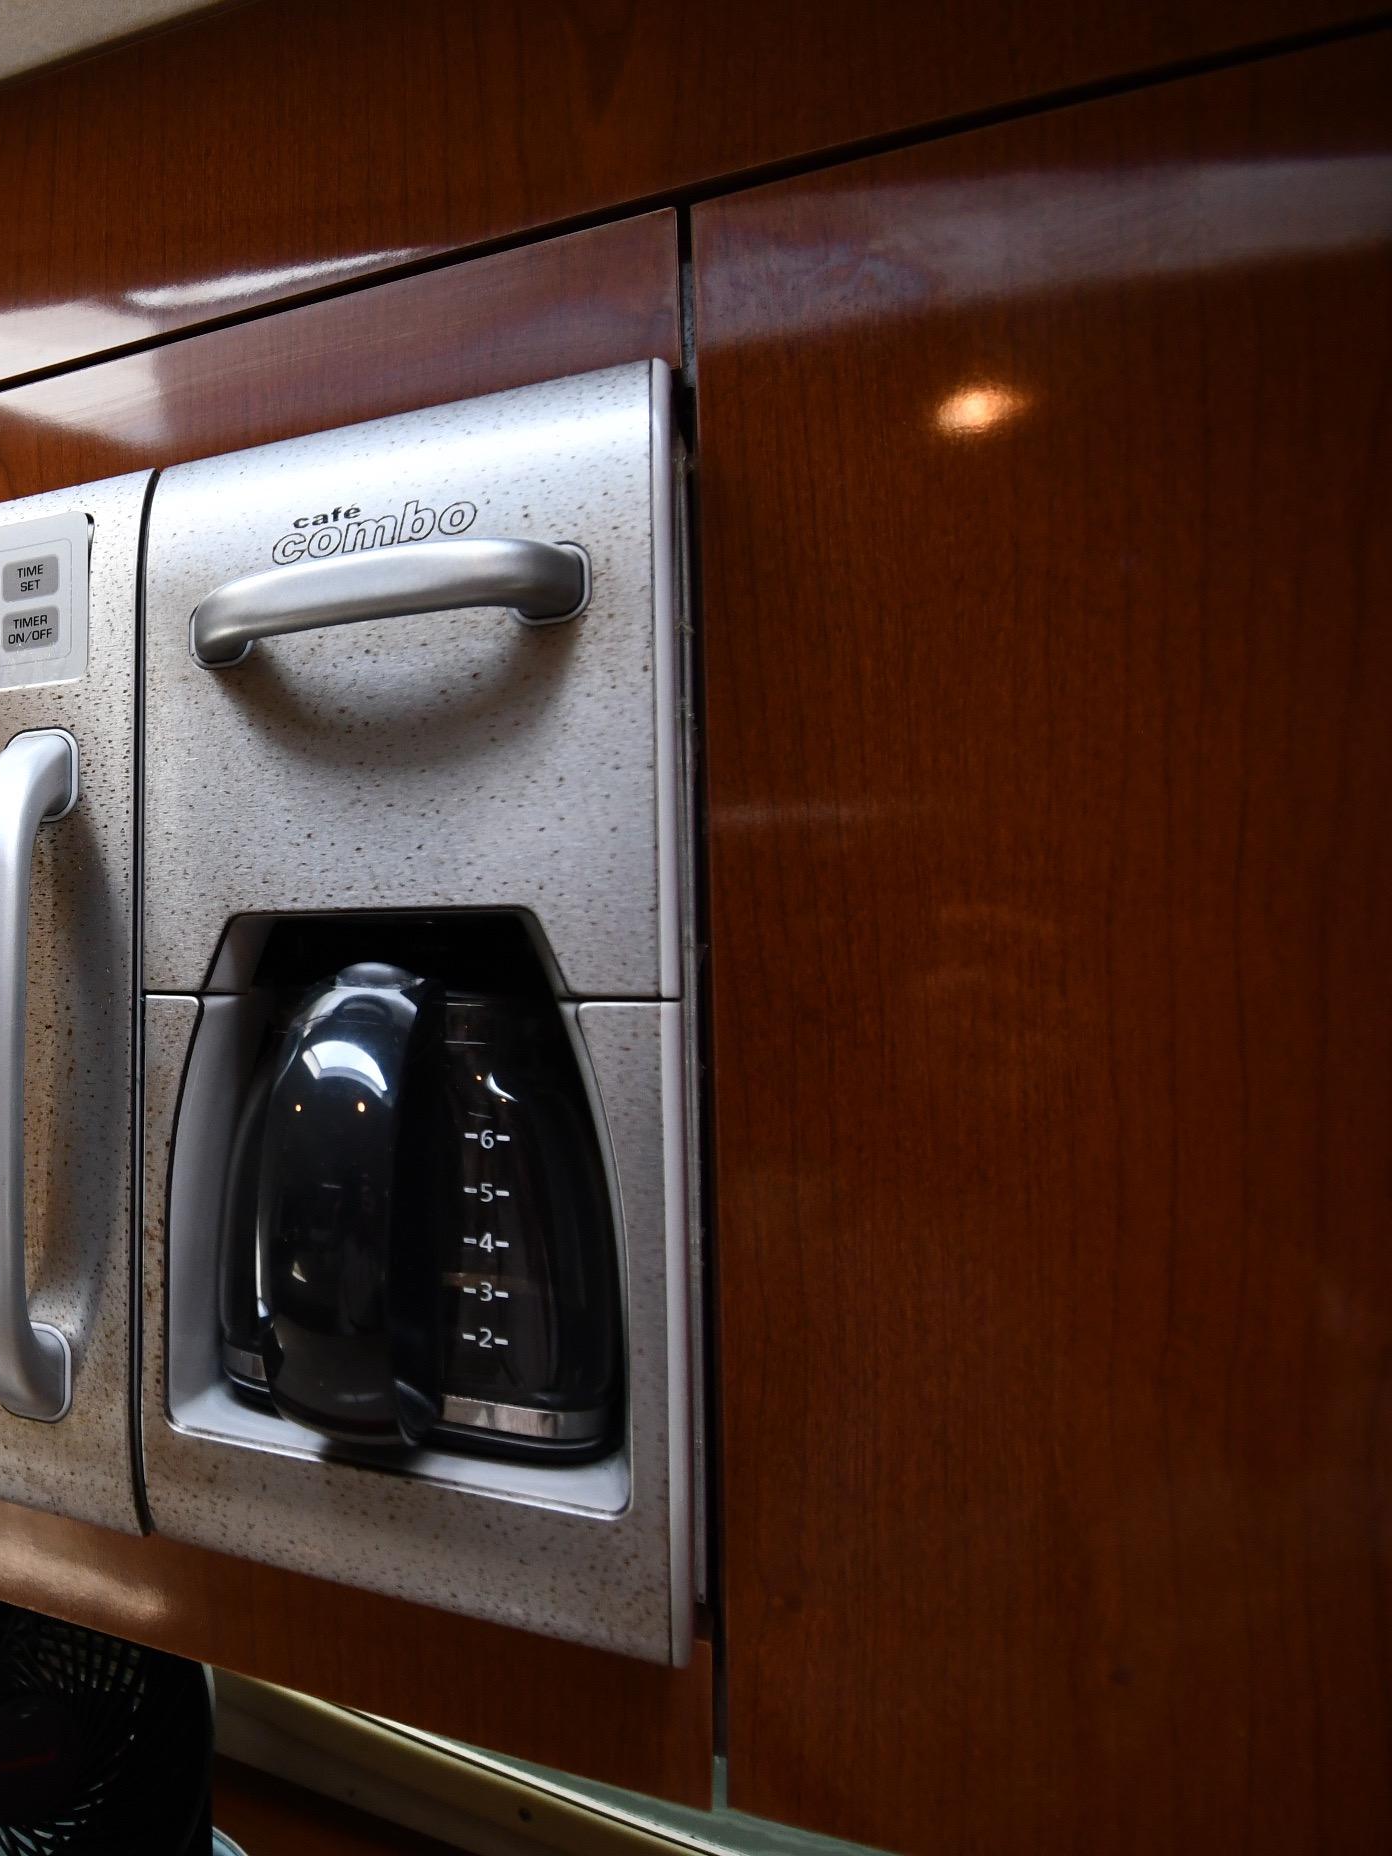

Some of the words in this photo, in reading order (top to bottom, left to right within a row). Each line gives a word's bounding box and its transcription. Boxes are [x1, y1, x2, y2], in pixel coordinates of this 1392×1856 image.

[293, 502, 361, 529] café
[272, 499, 477, 566] combo
[17, 564, 44, 578] TIME
[20, 579, 40, 592] SET
[12, 614, 48, 629] TIMER
[8, 628, 53, 644] ON/OFF
